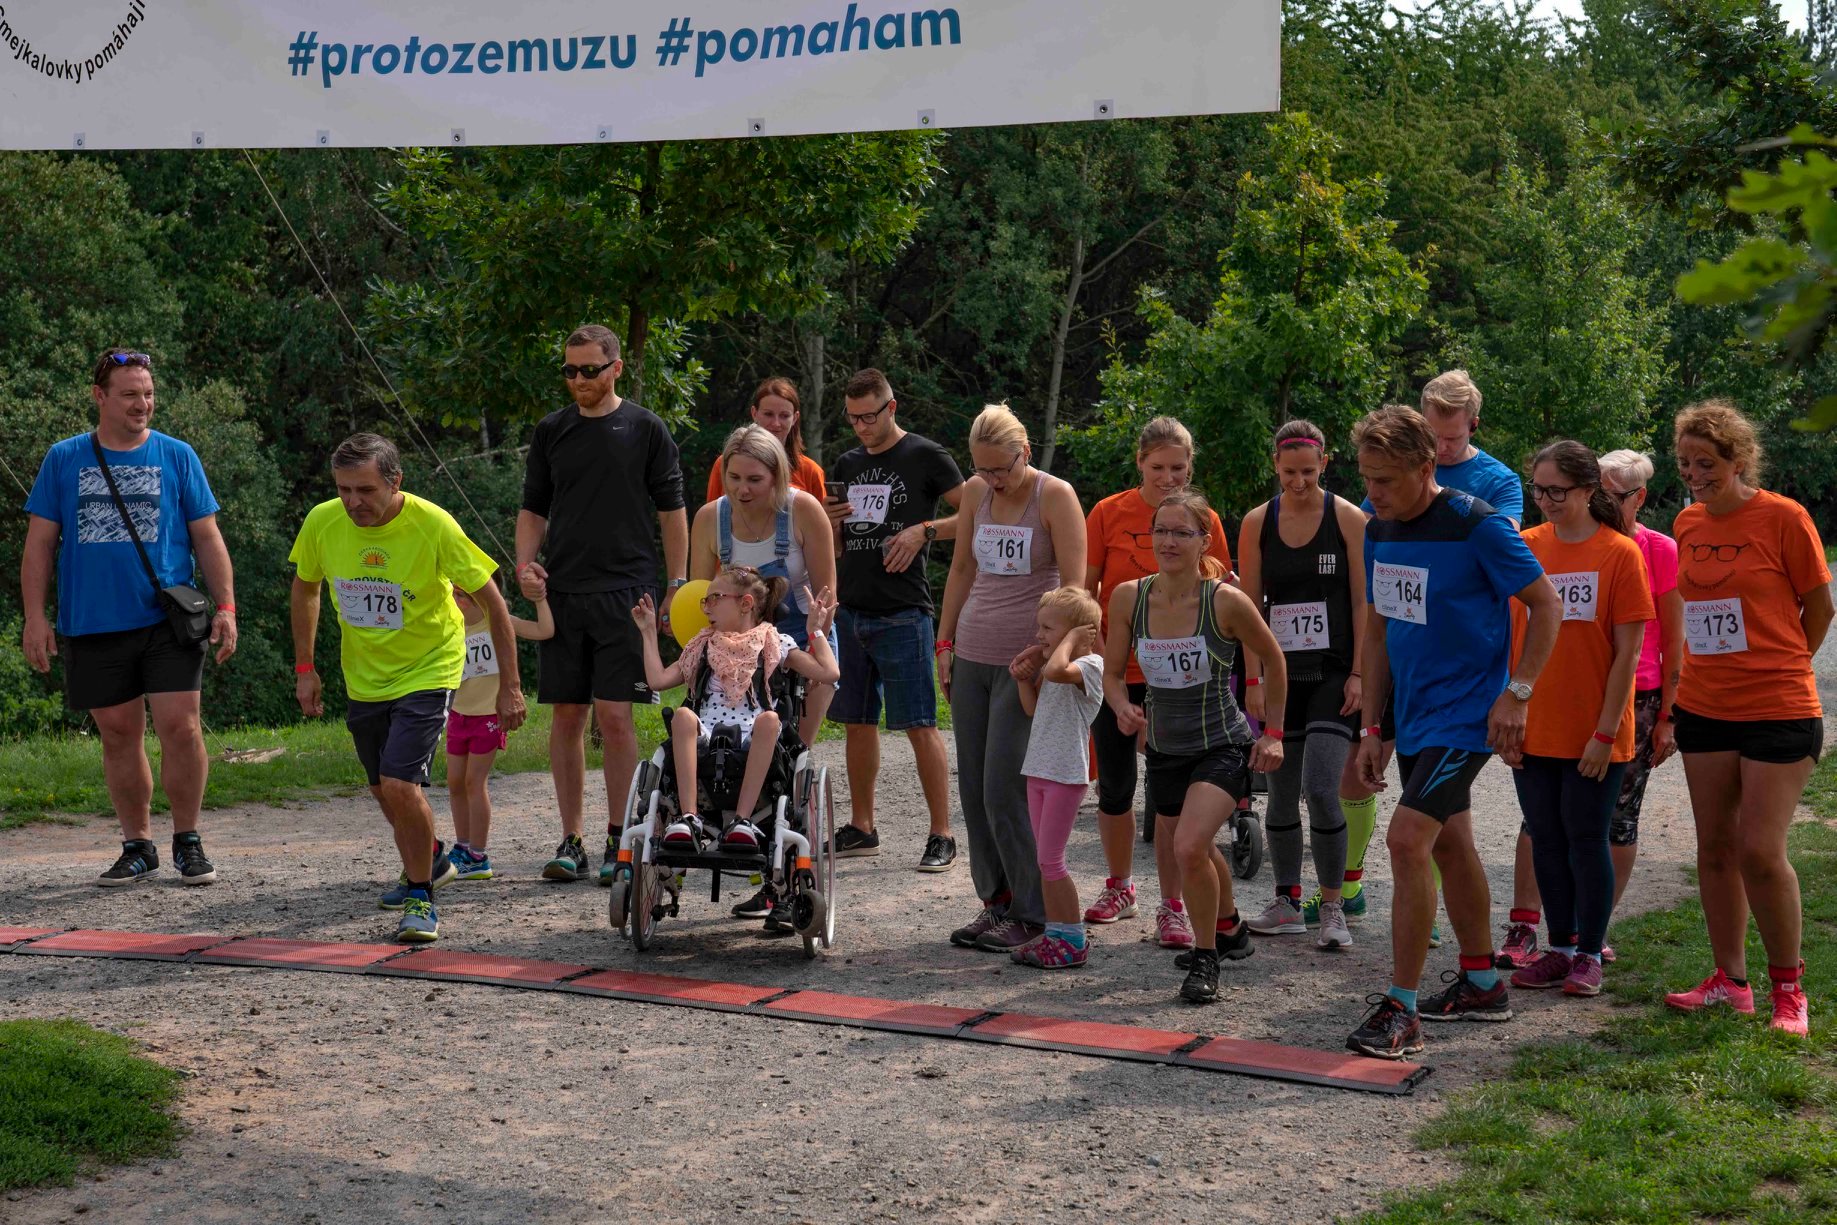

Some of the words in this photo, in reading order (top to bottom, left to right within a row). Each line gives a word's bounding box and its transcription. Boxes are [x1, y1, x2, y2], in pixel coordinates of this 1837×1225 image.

[288, 31, 637, 89] #protozemuzu
[655, 3, 961, 78] #pomaham
[85, 501, 113, 510] URBAN
[115, 501, 152, 510] NAMIC
[862, 494, 885, 510] 176
[983, 527, 1025, 538] ROSSMANN
[997, 538, 1025, 560] 161
[1318, 553, 1336, 564] EVER
[1318, 564, 1336, 575] LAST
[1376, 565, 1420, 580] ROSSMANN
[340, 581, 393, 594] ROSSMANN
[1549, 575, 1590, 585] SSMANN
[1396, 579, 1422, 605] 164
[1558, 584, 1593, 604] 163
[363, 593, 398, 614] 178
[1273, 605, 1320, 617] ROSSMANN
[1687, 602, 1732, 614] ROSSMANN
[1291, 615, 1324, 635] 175
[1703, 613, 1739, 636] 173
[1144, 640, 1197, 652] ROSSMANN
[1167, 650, 1202, 673] 167
